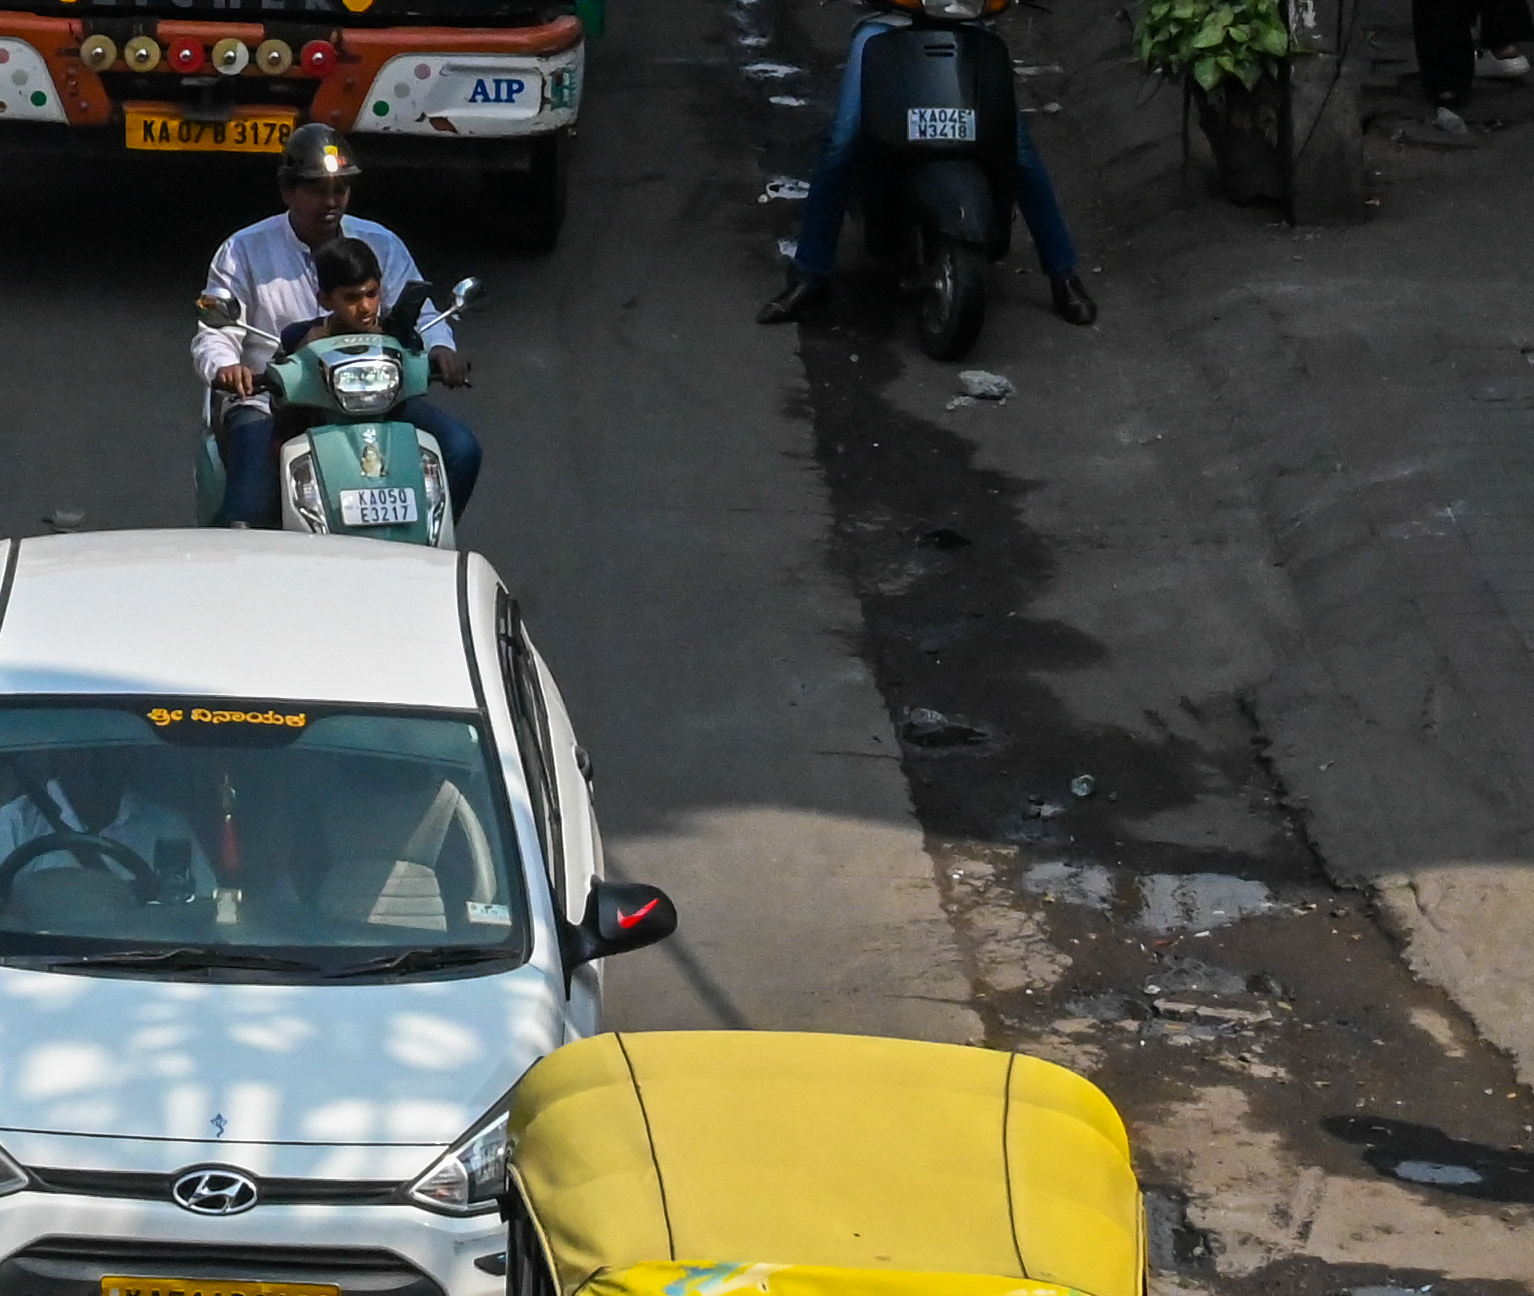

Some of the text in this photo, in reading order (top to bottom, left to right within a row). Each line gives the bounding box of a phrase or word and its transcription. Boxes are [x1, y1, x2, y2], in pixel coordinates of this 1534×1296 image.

[468, 78, 525, 103] AIP
[360, 506, 408, 523] E3217
[191, 707, 307, 728] ವಿನಾಯಕ
